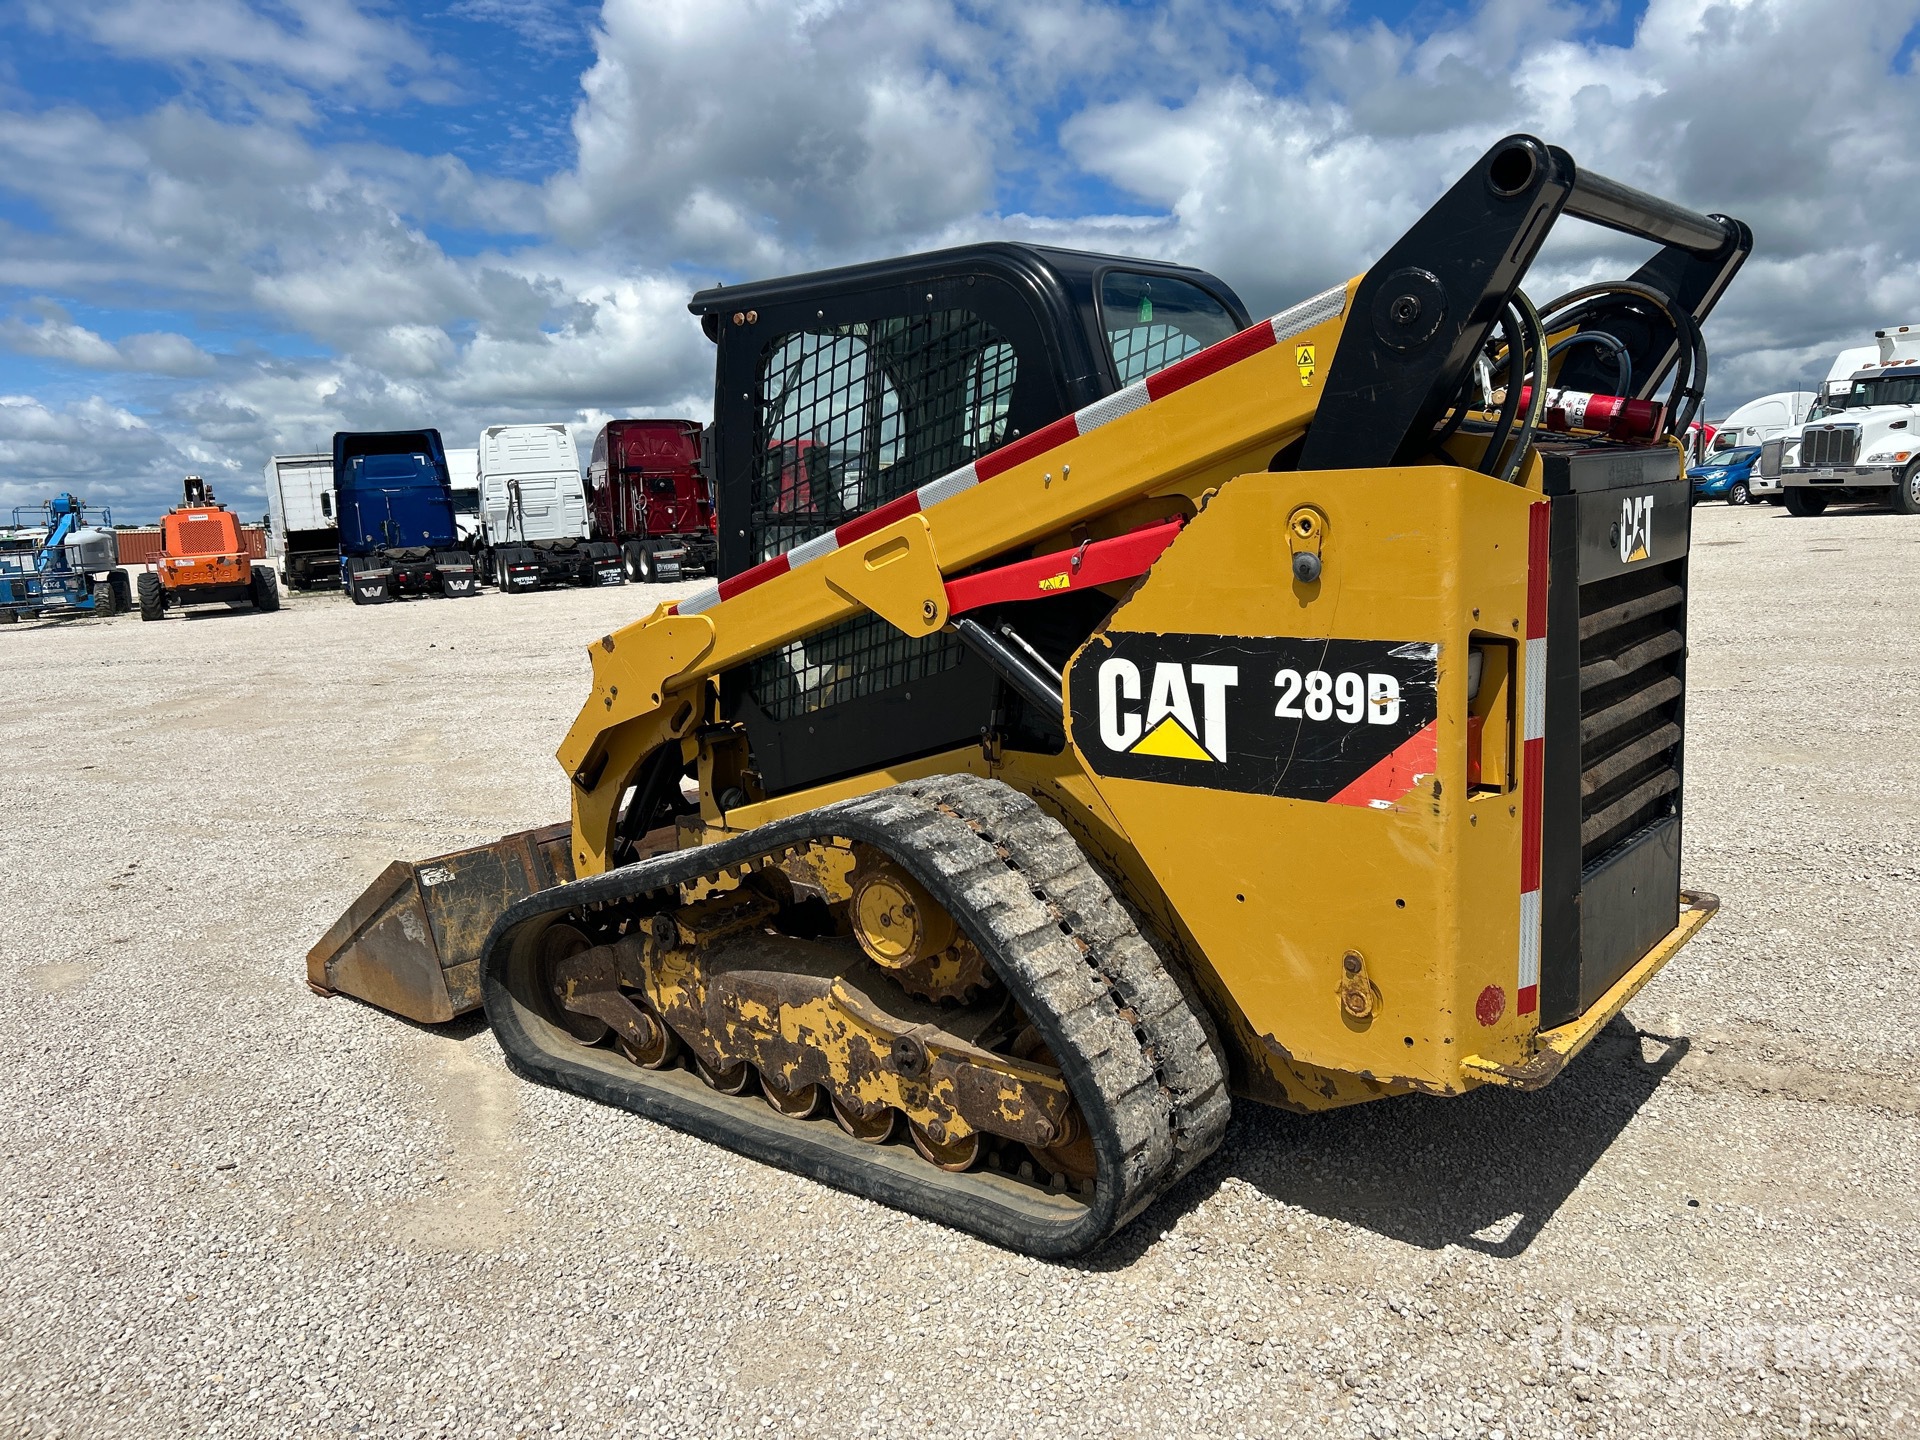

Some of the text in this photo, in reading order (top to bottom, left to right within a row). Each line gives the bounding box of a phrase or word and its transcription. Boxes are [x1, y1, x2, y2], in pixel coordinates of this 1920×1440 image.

[1620, 494, 1654, 564] CAT
[1098, 657, 1400, 763] CAT 289D
